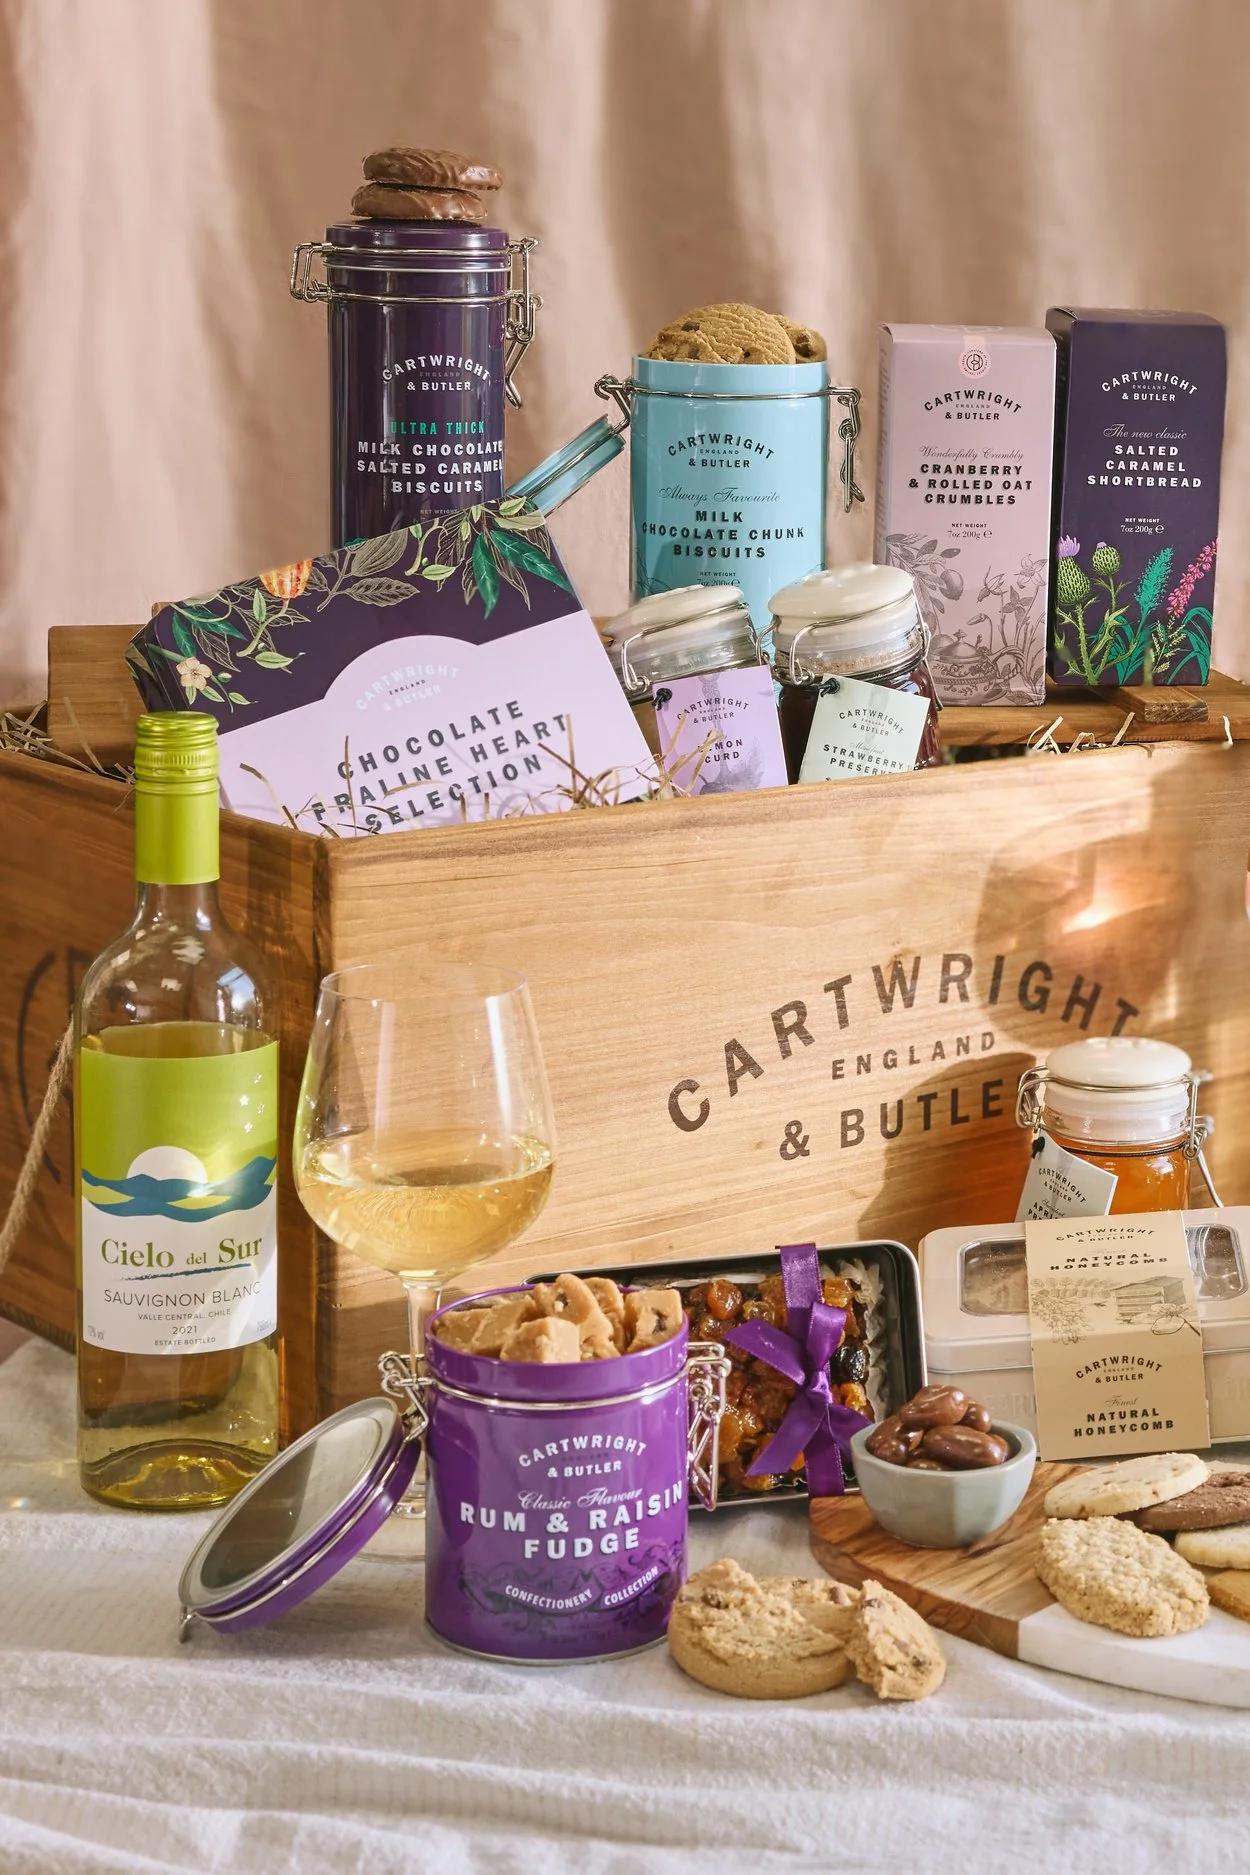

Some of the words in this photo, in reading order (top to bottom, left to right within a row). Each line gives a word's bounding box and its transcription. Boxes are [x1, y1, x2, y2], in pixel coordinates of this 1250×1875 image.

[382, 354, 490, 383] CARTWRIGHT
[421, 381, 472, 392] BUTLER
[1102, 371, 1197, 395] CARTWRIGHT
[924, 390, 1022, 414] CARTWRIGHT
[1134, 393, 1176, 401] BUTLER
[957, 412, 1000, 420] BUTLER
[390, 422, 437, 434] ULTRA
[446, 421, 485, 434] THICK
[358, 441, 401, 455] MILK
[412, 440, 503, 456] CHOCOLATE
[668, 433, 774, 459] CARTWRIGHT
[1115, 445, 1179, 456] SALTED
[357, 460, 426, 475] SALTED
[437, 458, 503, 475] CARAMEL
[701, 458, 750, 468] BUTLER
[921, 464, 1023, 475] CRANBERRY
[1106, 461, 1185, 472] CARAMEL
[392, 480, 482, 493] BISCUITS
[928, 479, 993, 489] ROLLED
[1003, 481, 1032, 490] OAT
[1087, 475, 1202, 488] SHORTBREAD
[924, 494, 1016, 505] CRUMBLES
[695, 510, 743, 522] MILK
[642, 521, 738, 540] CHOCOLATE
[749, 527, 804, 540] CHUNK
[673, 544, 766, 557] BISCUITS
[356, 664, 459, 710] CARTWRIGHT
[389, 680, 426, 695] ENGLAND
[702, 712, 734, 722] BUTLER
[839, 709, 904, 734] CARTWRIGHT
[469, 714, 568, 763] HEART
[860, 725, 889, 737] BUTLER
[338, 700, 523, 780] CHOCOLATE
[705, 751, 740, 764] CURD
[823, 744, 904, 770] STRAWBERRY
[365, 754, 542, 832] SELECTION
[668, 953, 1139, 1132] CARTWRIGHT
[832, 1031, 995, 1080] ENGLAND
[779, 1120, 810, 1160] &
[1039, 1168, 1087, 1203] CARTWRIGHT
[1056, 1228, 1156, 1241] CARTWRIGHT
[101, 1238, 174, 1268] Cielo
[186, 1252, 207, 1265] del
[218, 1238, 262, 1263] Sur
[1066, 1252, 1152, 1263] NATURAL
[1050, 1257, 1169, 1270] HONEYCOMB
[104, 1289, 205, 1307] SAUVIGNON
[212, 1281, 261, 1304] BLANC
[138, 1313, 162, 1321] VALLE
[208, 1308, 231, 1318] CHILE
[172, 1325, 197, 1335] 2021
[184, 1337, 216, 1345] BOTTLED
[1076, 1355, 1163, 1379] CARTWRIGHT
[1106, 1373, 1144, 1382] BUTLER
[1104, 1396, 1139, 1408] Finest
[1087, 1408, 1160, 1422] NATURAL
[1074, 1420, 1174, 1437] HONEYCOMB
[518, 1435, 646, 1467] CARTWRIGHT
[564, 1460, 622, 1477] BUTLER
[517, 1490, 571, 1510] Classic
[577, 1487, 642, 1506] Flavour
[460, 1502, 525, 1532] RUM
[546, 1512, 569, 1533] &
[589, 1480, 682, 1530] RAISIN
[524, 1527, 639, 1559] FUDGE
[505, 1585, 593, 1610] CONFECTIONERY
[604, 1566, 659, 1605] COLLECTION
